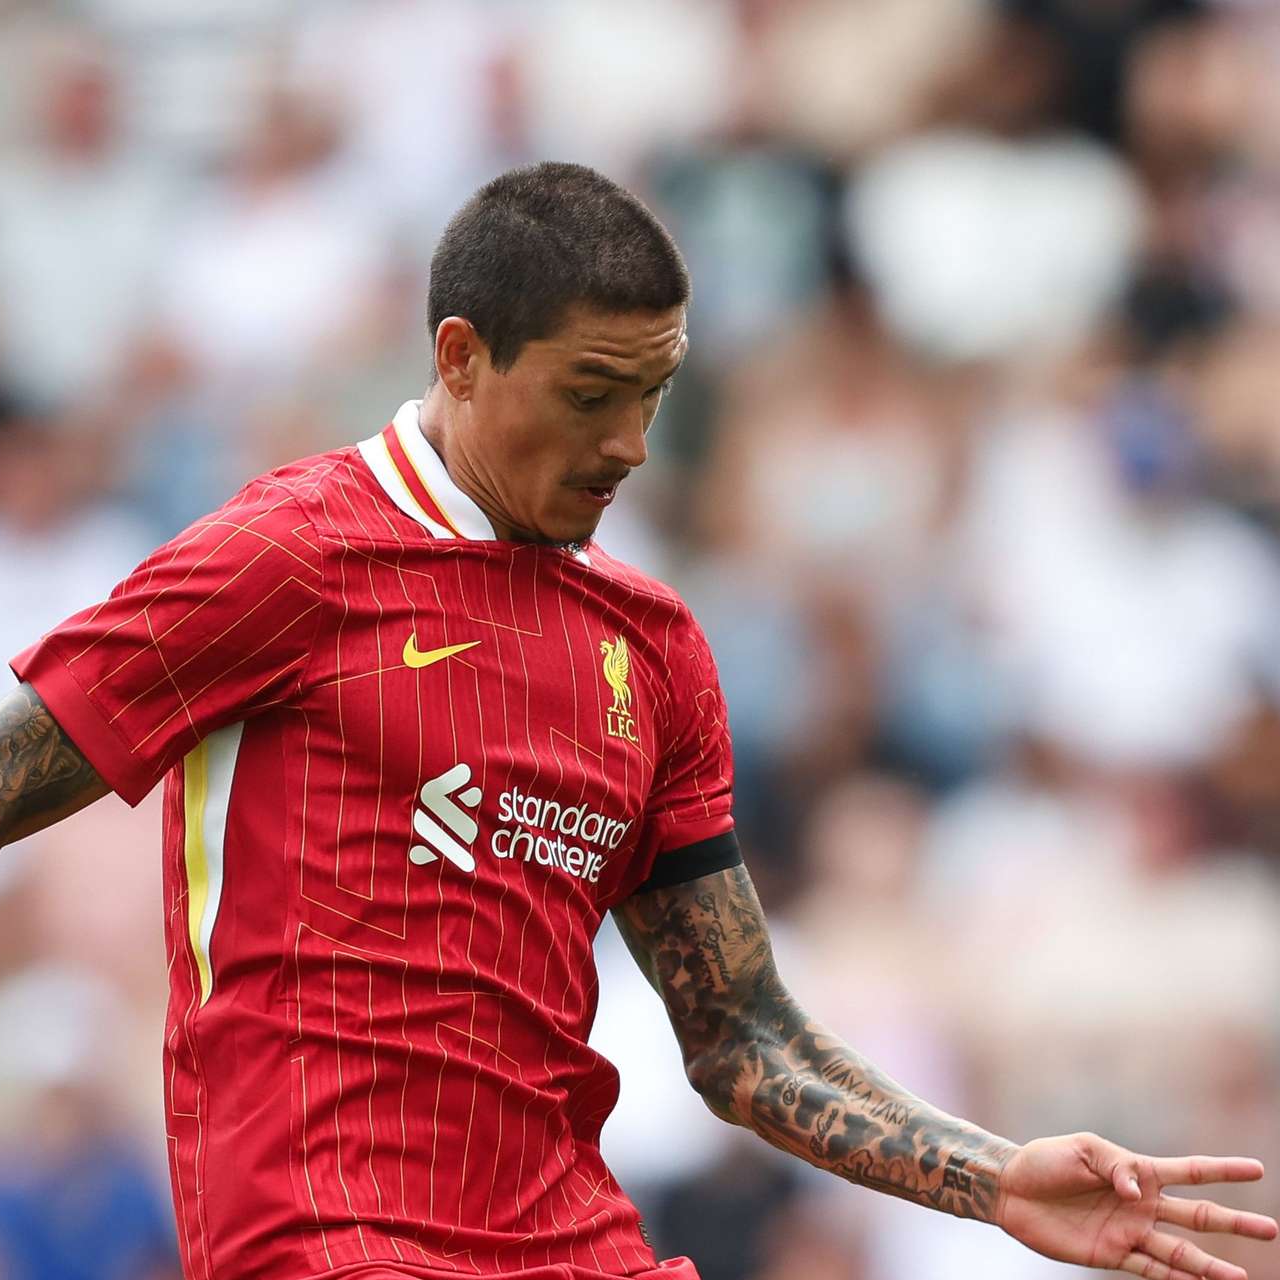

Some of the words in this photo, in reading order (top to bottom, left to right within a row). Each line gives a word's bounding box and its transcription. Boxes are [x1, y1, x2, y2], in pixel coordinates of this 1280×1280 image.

[606, 713, 639, 742] L.F.C.
[497, 785, 634, 850] standard
[491, 825, 603, 883] chartere
